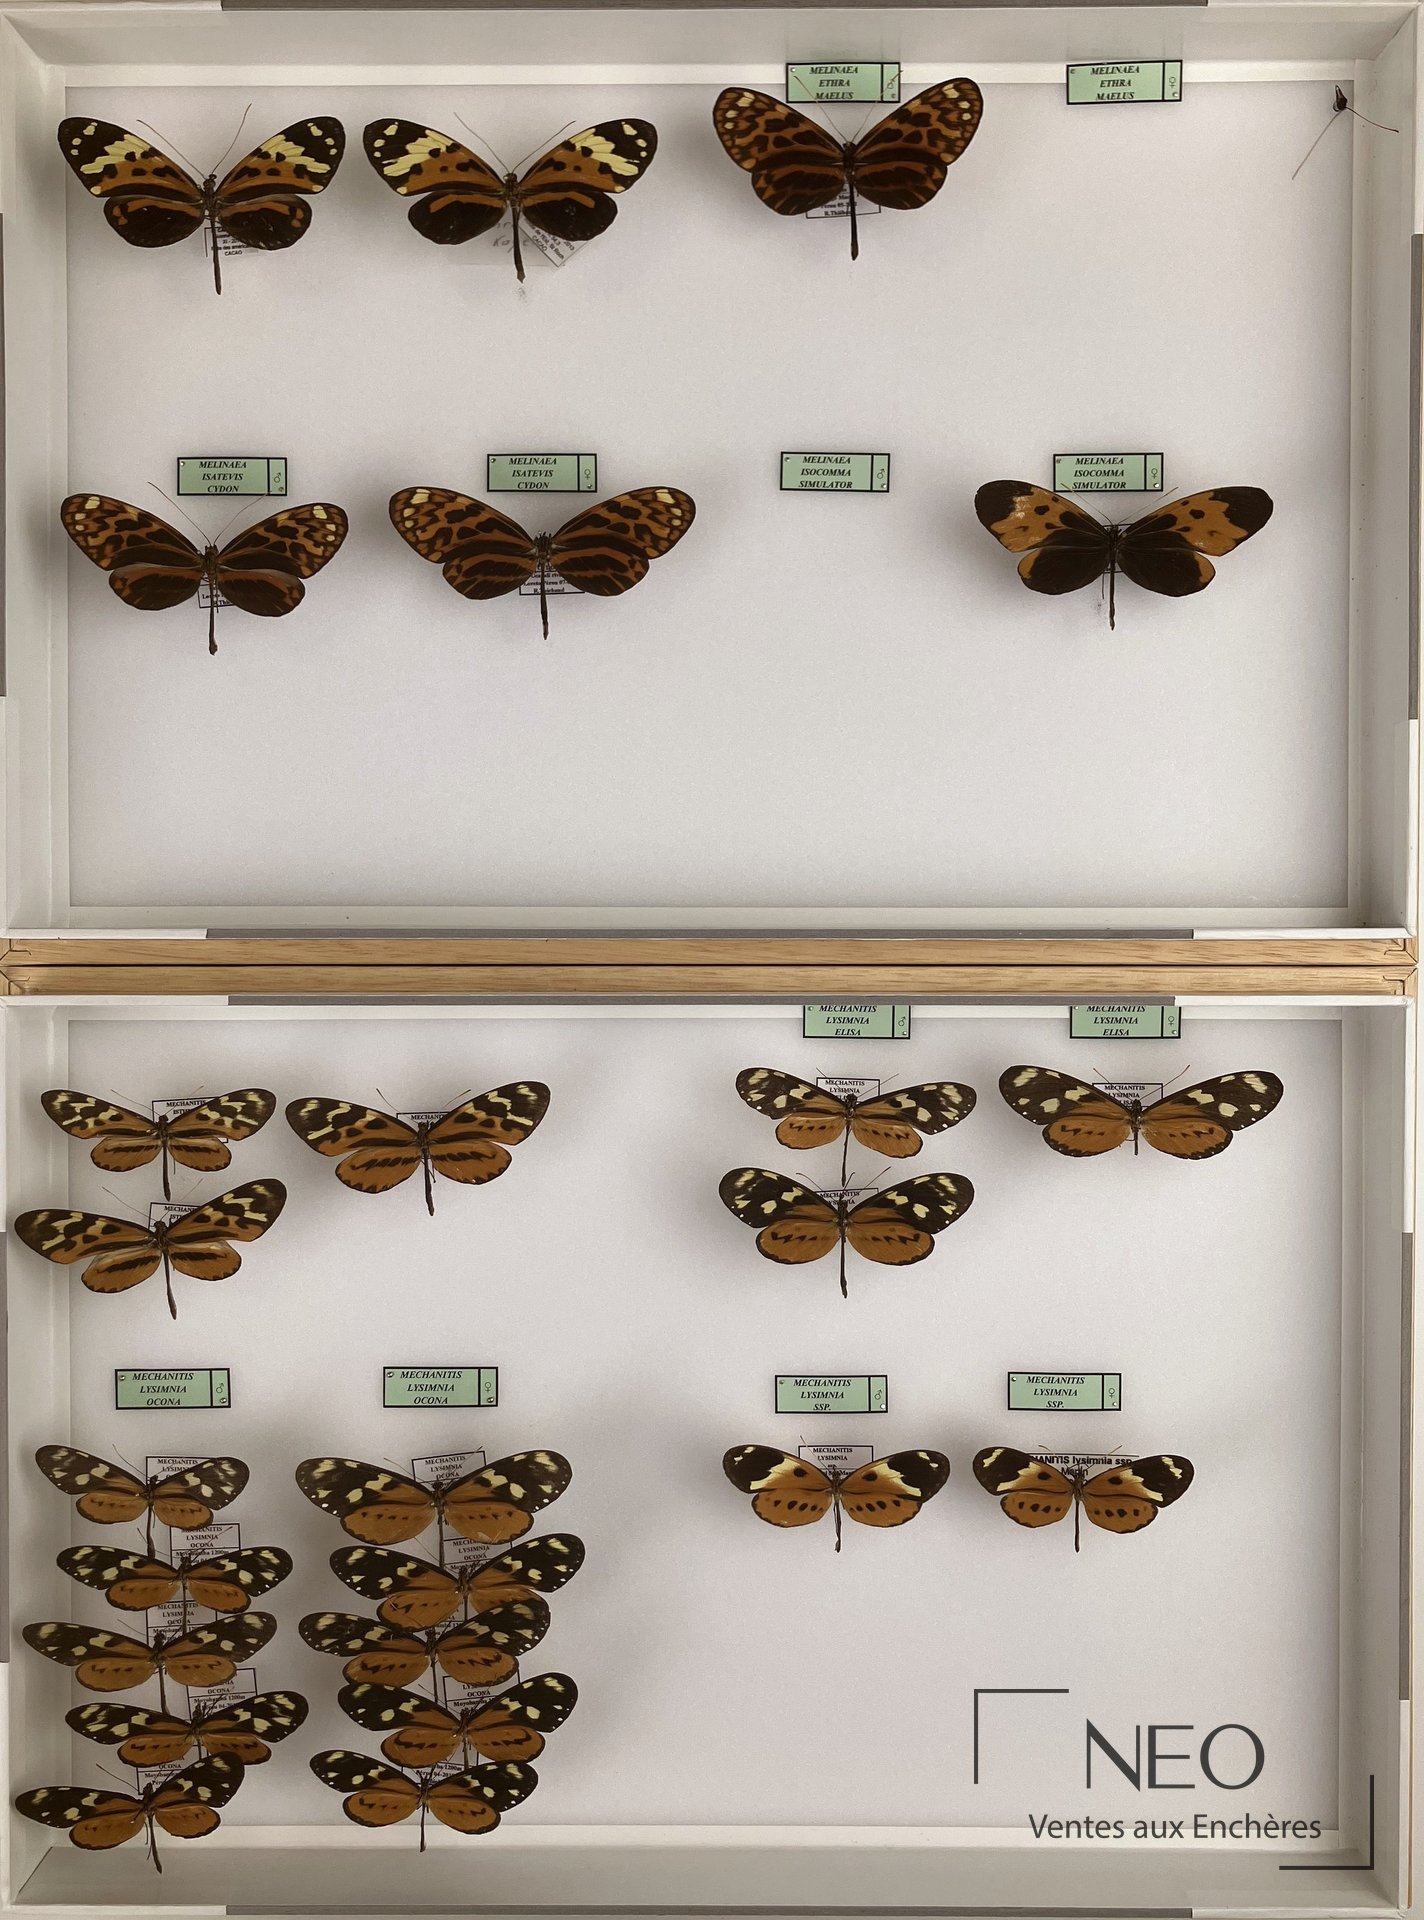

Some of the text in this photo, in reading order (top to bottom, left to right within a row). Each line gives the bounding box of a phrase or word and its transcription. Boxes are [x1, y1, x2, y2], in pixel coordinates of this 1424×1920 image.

[809, 66, 859, 75] MELINAEA
[1090, 65, 1140, 75] MELINAEA
[819, 79, 850, 87] ETHRA
[1100, 79, 1131, 88] ETHRA
[814, 92, 854, 100] MAELUS
[1096, 92, 1135, 101] MAELUS
[802, 456, 851, 464] MELINAEA
[1075, 457, 1124, 465] MELINAEA
[199, 461, 247, 469] MELINAEA
[800, 468, 851, 476] ISOCOMMA
[202, 473, 243, 481] ISATEVIS
[819, 1005, 877, 1013] MECHANITIS
[132, 1373, 194, 1381] MECHANITIS
[400, 1371, 463, 1379] MECHANITIS
[793, 1379, 852, 1387] MECHANITIS
[1026, 1376, 1085, 1384] MECHANITIS
[800, 1391, 844, 1399] LYSIMNIA
[1033, 1388, 1078, 1396] LYSIMNIA
[147, 1398, 181, 1406] OCONA
[425, 1456, 466, 1465] MECHANITIS
[1072, 1456, 1112, 1465] lysimnia
[430, 1464, 463, 1472] LYSIMNIA
[458, 1545, 490, 1553] LYSIMNIA
